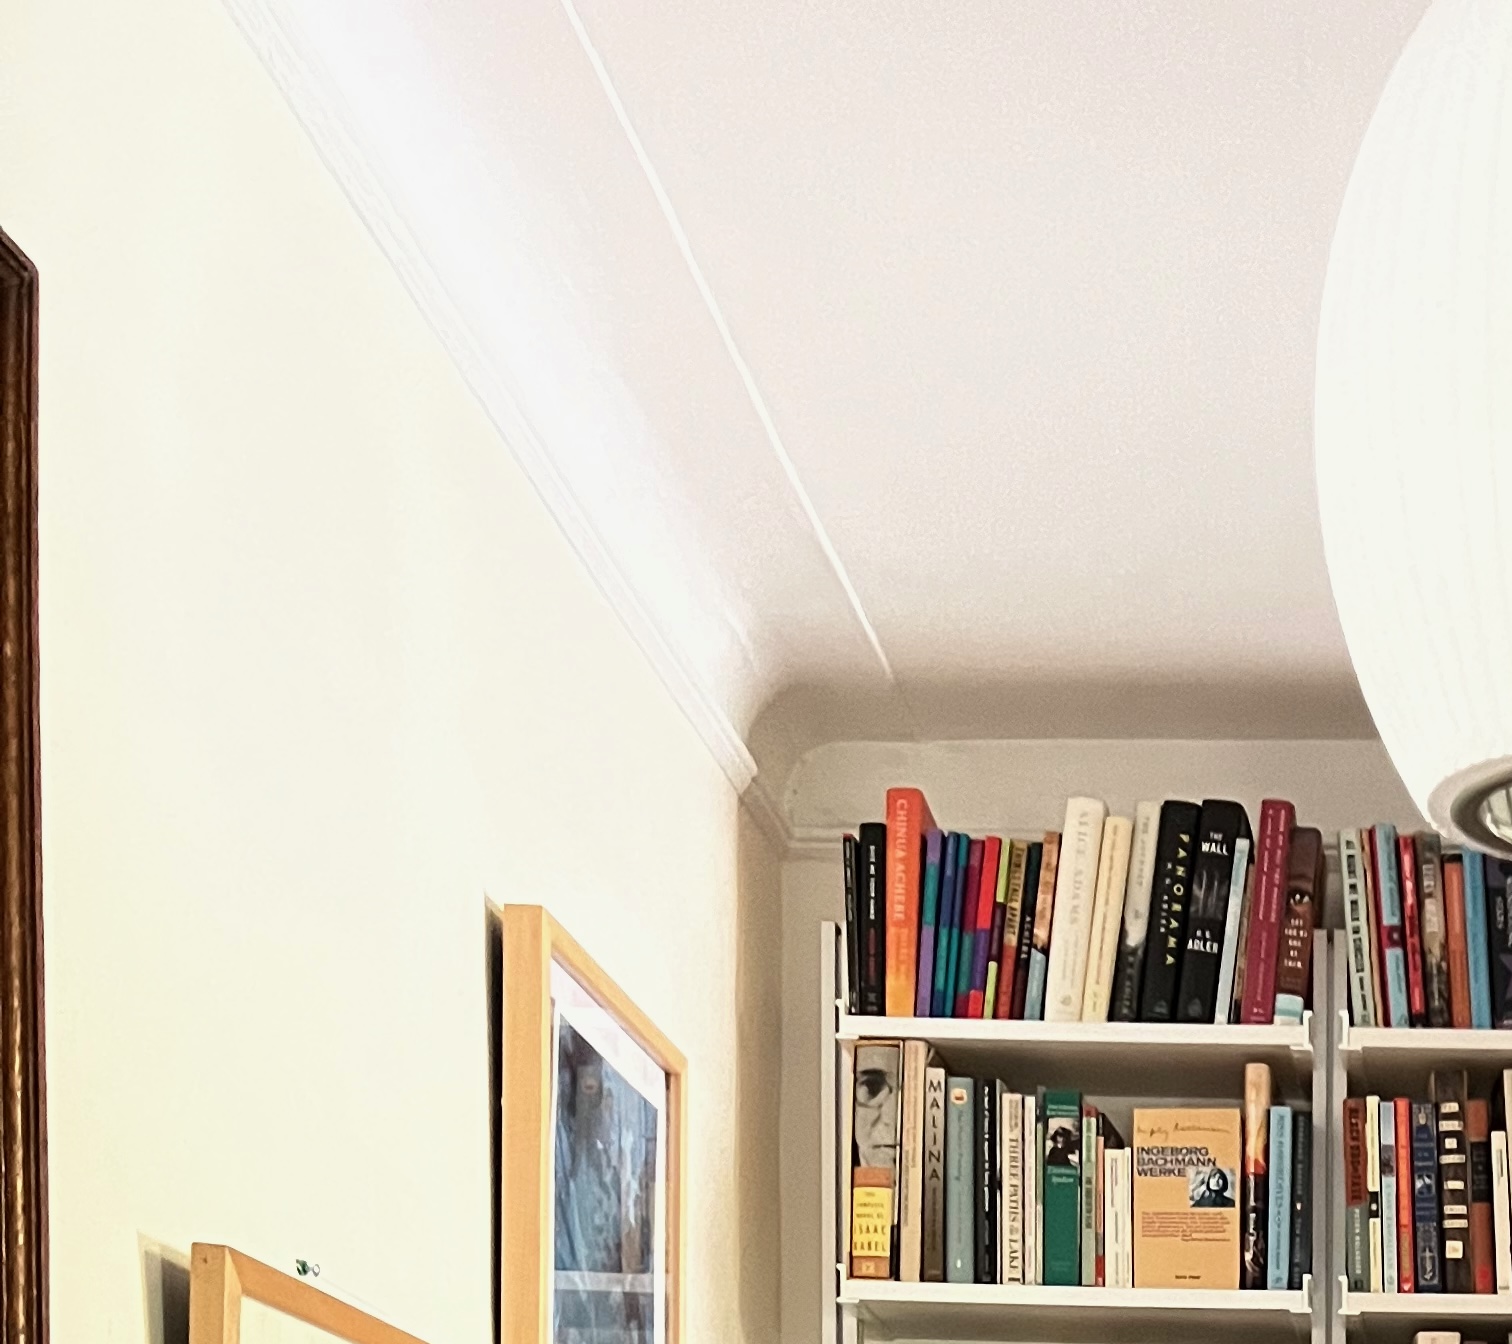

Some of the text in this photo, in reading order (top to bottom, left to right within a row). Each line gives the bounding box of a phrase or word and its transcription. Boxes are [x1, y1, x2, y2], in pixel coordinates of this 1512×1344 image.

[1201, 842, 1228, 856] WALL
[892, 799, 909, 922] CHINUA ACHEBE
[1164, 834, 1190, 967] PANORAMA
[1187, 938, 1218, 954] ADLER
[927, 1078, 942, 1182] MALINA
[1136, 1146, 1210, 1157] INGEBORG
[1136, 1157, 1217, 1167] BACHMANN
[1136, 1167, 1187, 1178] WERKE
[1009, 1178, 1020, 1220] PATHS
[854, 1224, 888, 1236] ISAAC
